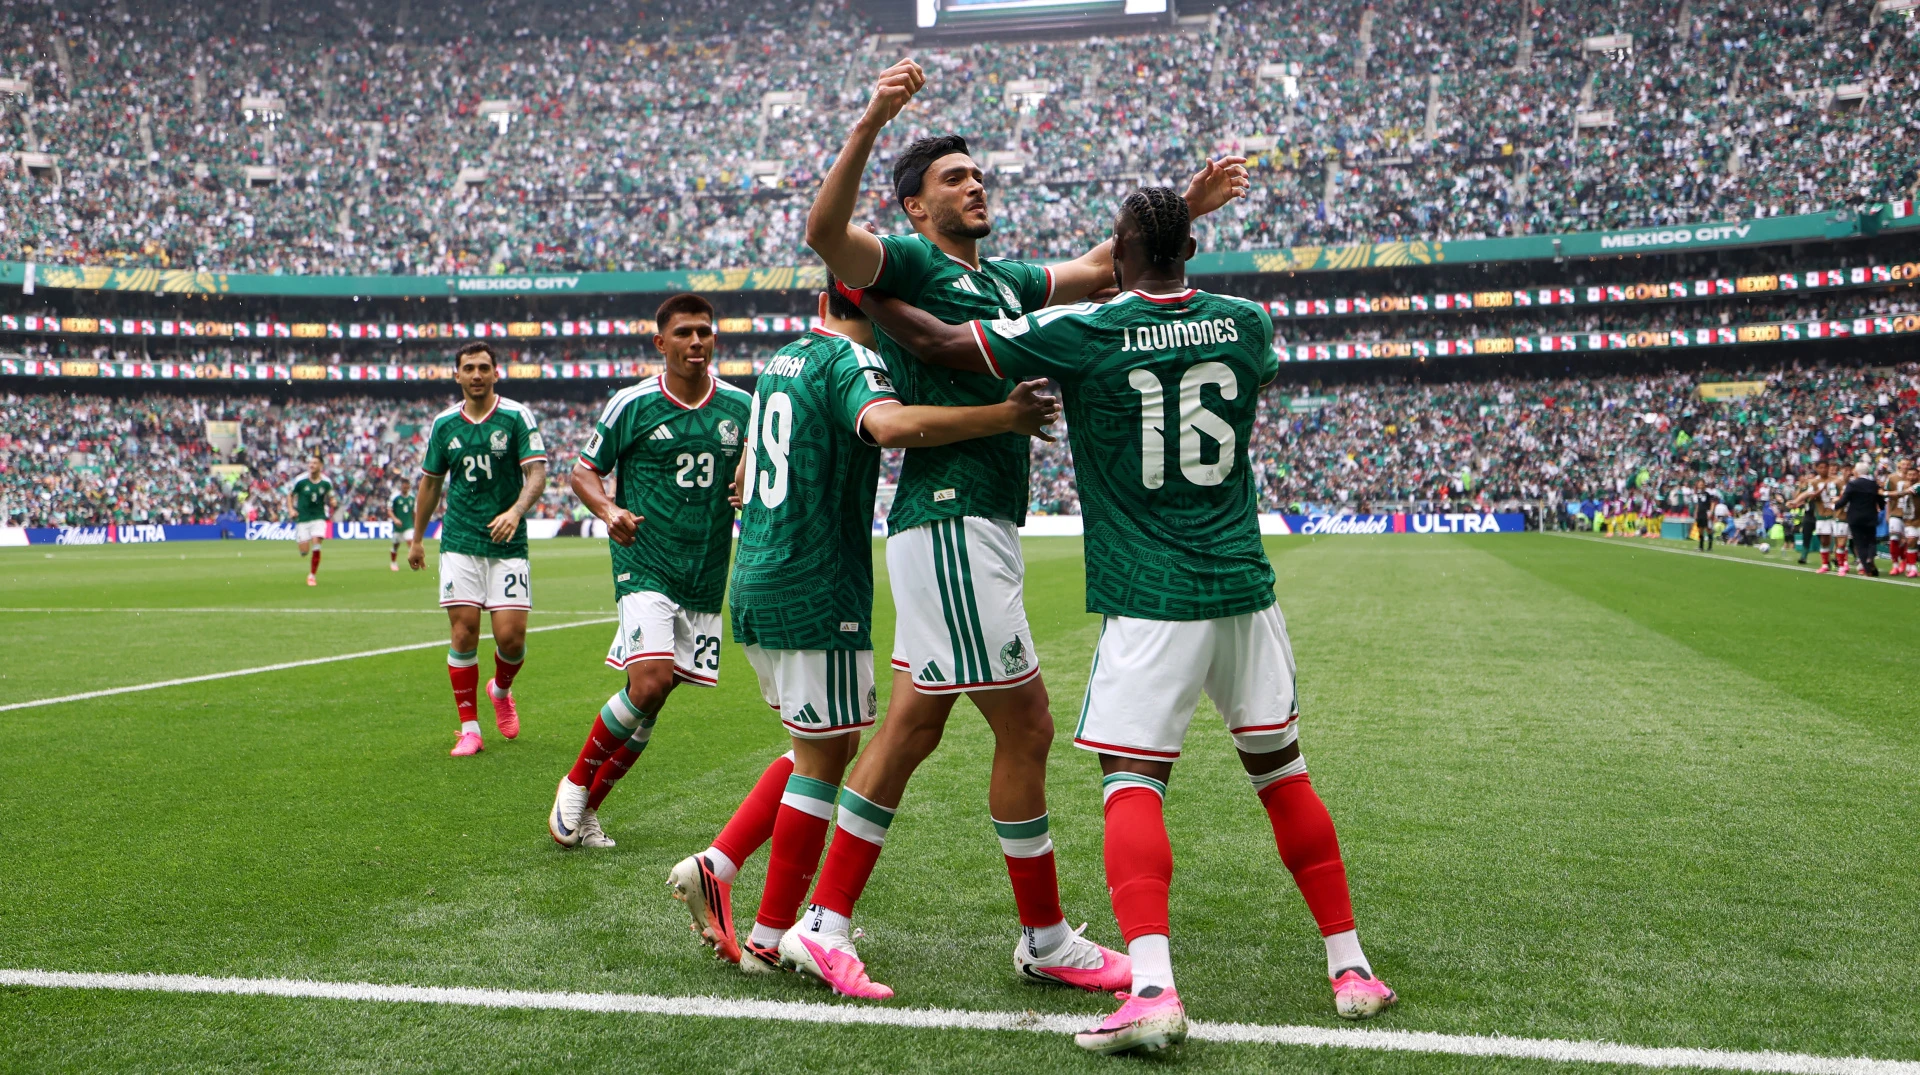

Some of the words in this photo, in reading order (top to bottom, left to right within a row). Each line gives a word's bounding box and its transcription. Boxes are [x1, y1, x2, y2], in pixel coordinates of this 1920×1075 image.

[1601, 229, 1692, 249] MEXICO
[1695, 224, 1750, 242] CITY
[458, 277, 532, 291] MEXICO
[534, 277, 579, 290] CITY
[1121, 317, 1239, 352] J.QUIÑONES
[1128, 361, 1238, 490] 16
[743, 390, 793, 509] 19
[463, 454, 493, 482] 24
[676, 452, 715, 488] 23
[56, 525, 106, 545] Michelob
[119, 524, 166, 543] ULTRA
[245, 520, 297, 541] Mich
[337, 521, 394, 539] ULTR
[1301, 512, 1389, 535] Michelob
[1412, 513, 1500, 533] ULTRA
[504, 573, 529, 598] 24
[694, 635, 721, 671] 23
